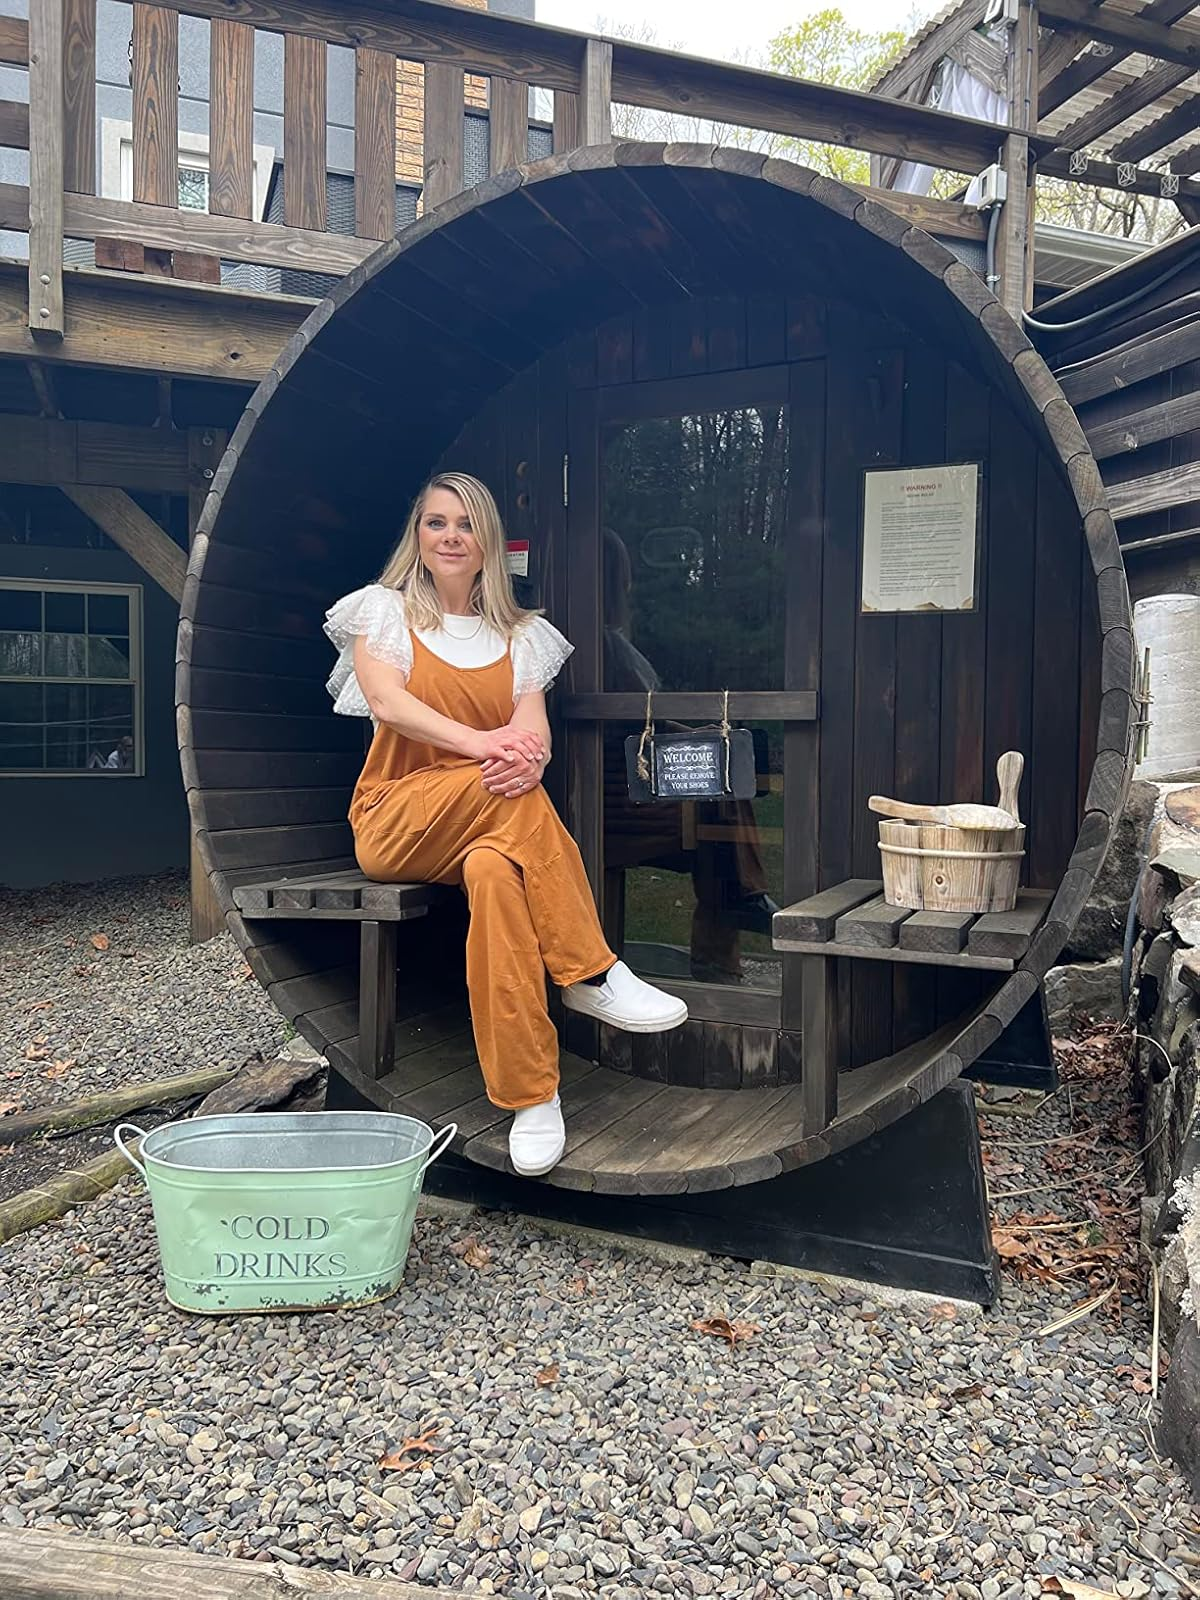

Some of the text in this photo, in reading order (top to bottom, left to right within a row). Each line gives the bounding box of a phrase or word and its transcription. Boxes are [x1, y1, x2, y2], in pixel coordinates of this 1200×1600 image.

[663, 752, 714, 763] WELCOME
[230, 1215, 330, 1240] COLD
[213, 1251, 348, 1278] DRINKS
